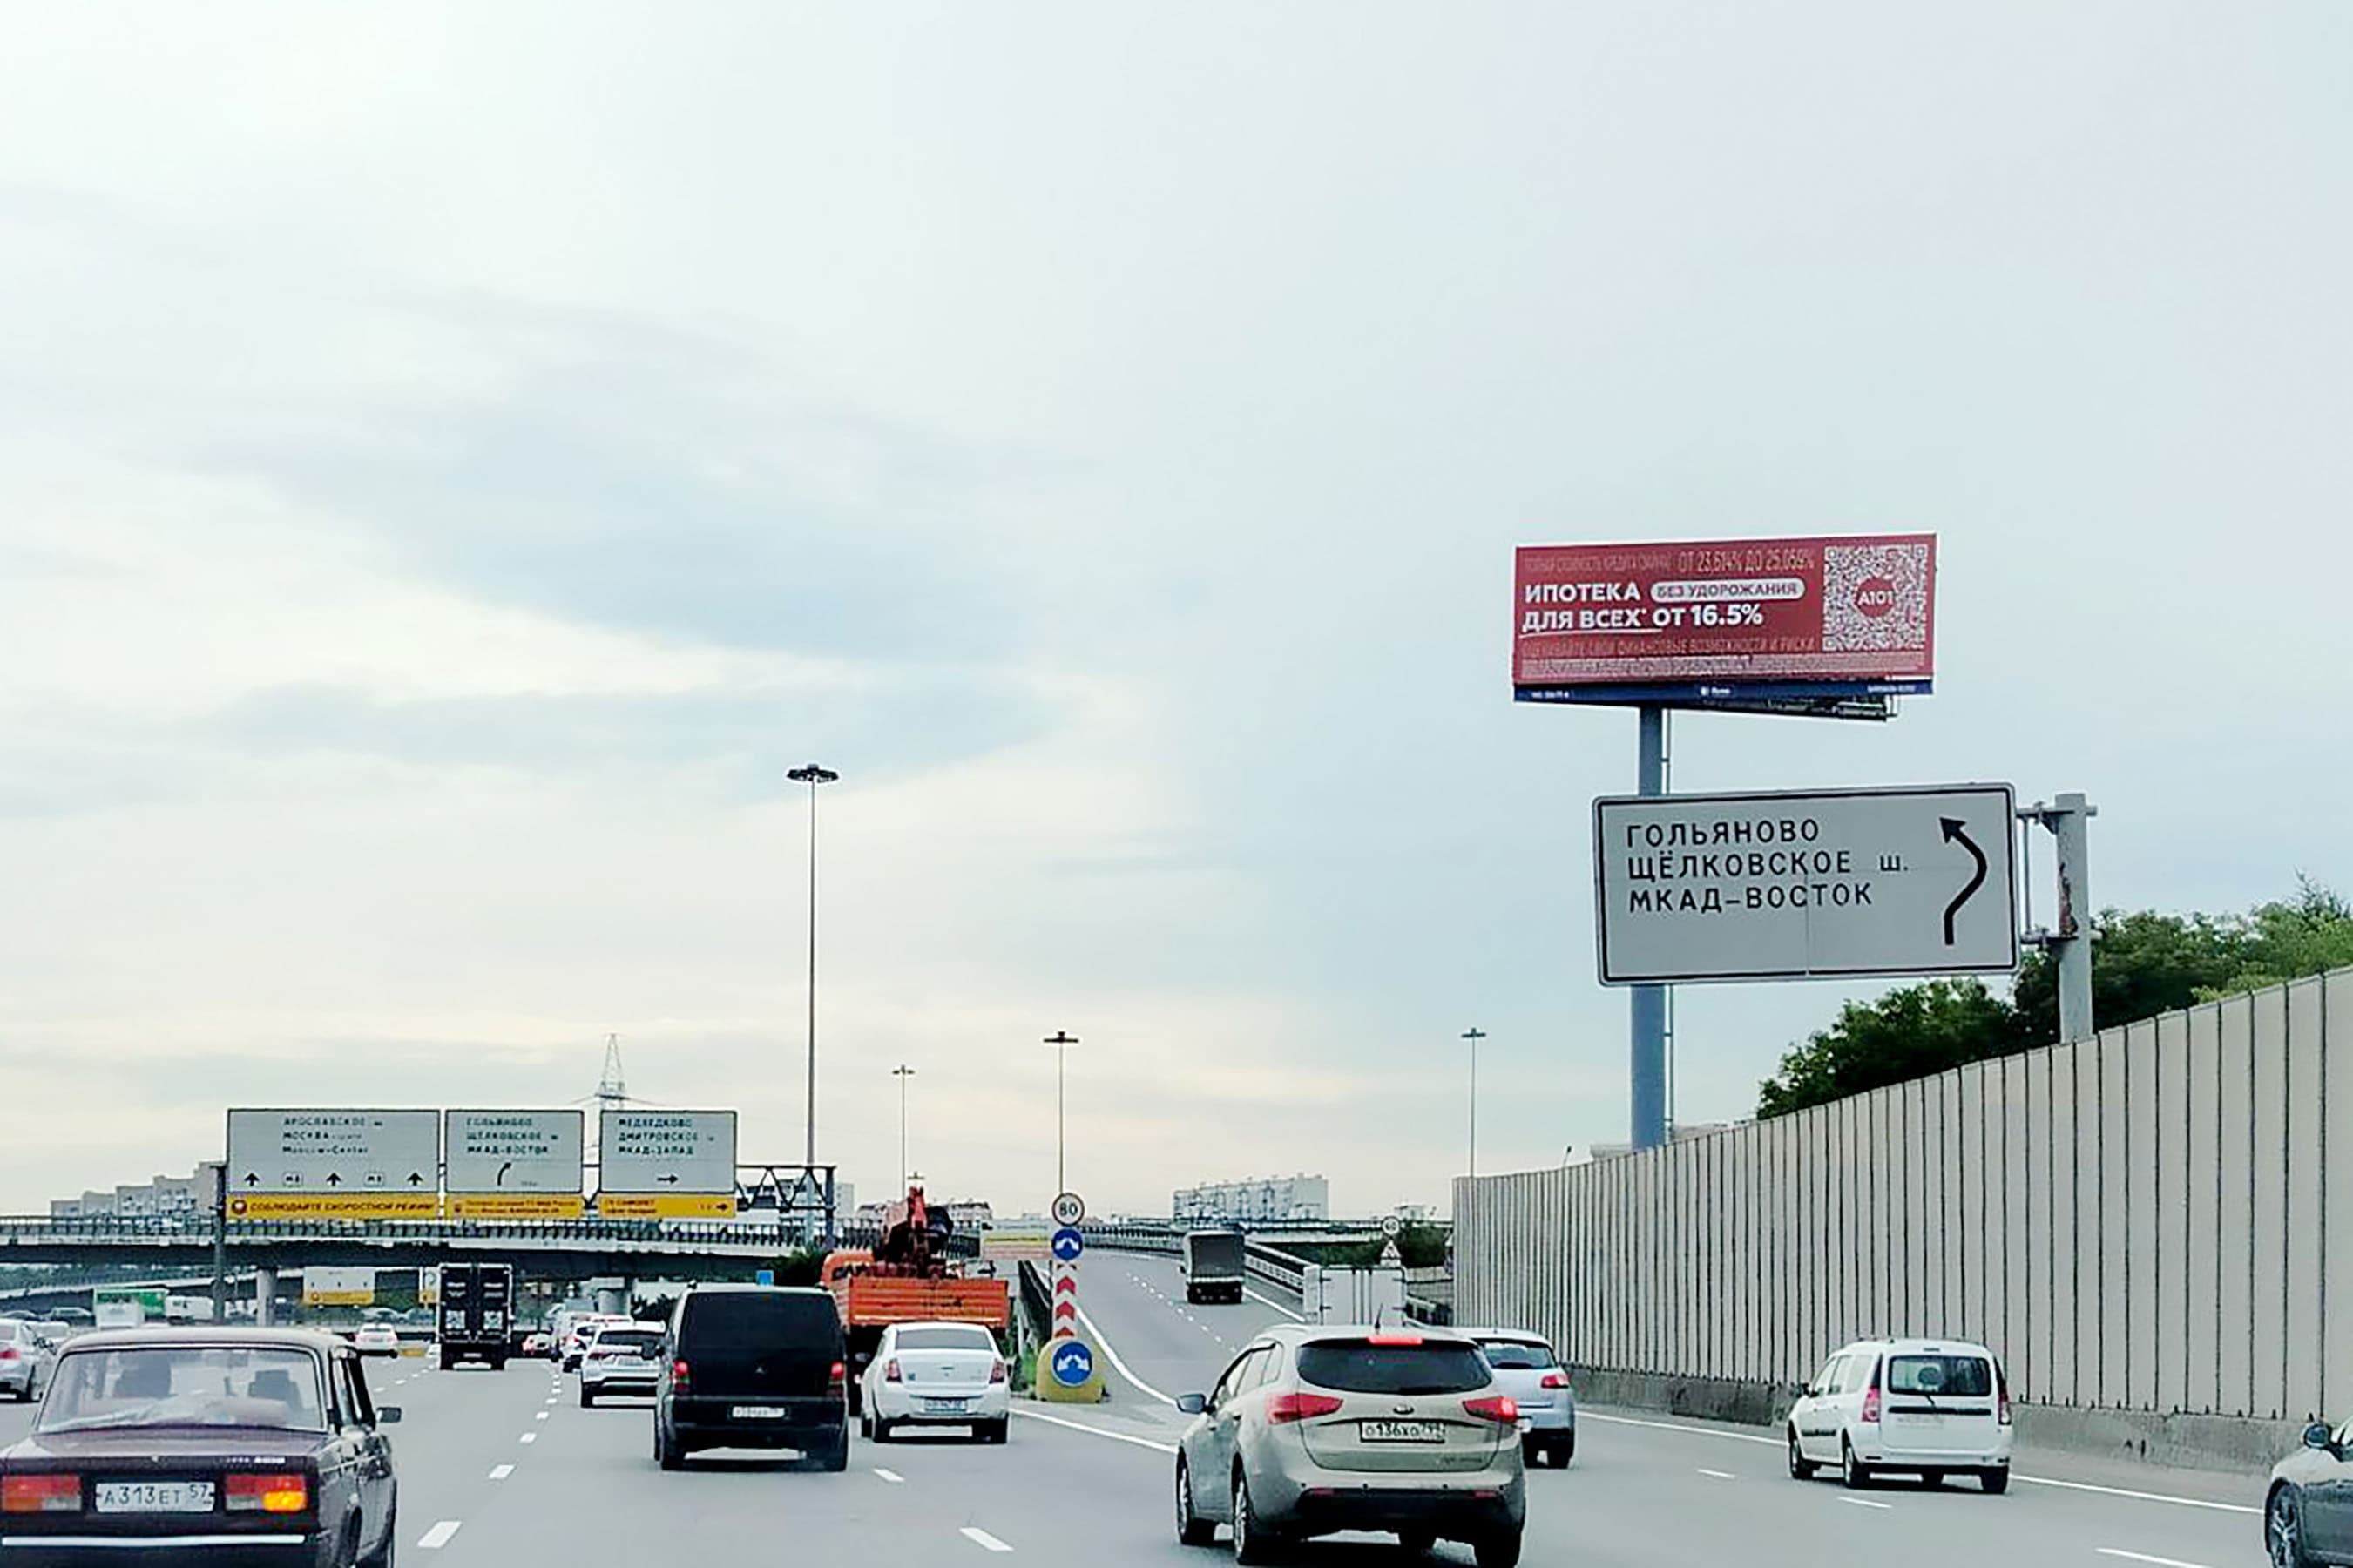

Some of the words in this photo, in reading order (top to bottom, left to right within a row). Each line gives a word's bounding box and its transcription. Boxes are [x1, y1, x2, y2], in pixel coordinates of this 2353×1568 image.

[1745, 550, 1762, 573] ДО
[1525, 582, 1641, 605] ИПОТЕКА
[1687, 582, 1798, 598] УДОРОЖАНИЯ
[1522, 613, 1572, 632] ДЛЯ
[1653, 608, 1686, 627] ОТ
[1691, 604, 1764, 625] 16.5%
[1627, 818, 1820, 848] ГОЛЬЯНОВО
[1628, 850, 1852, 882] ЩЁЛКОВСКОЕ
[1059, 1202, 1078, 1217] 80
[189, 1484, 210, 1499] 57
